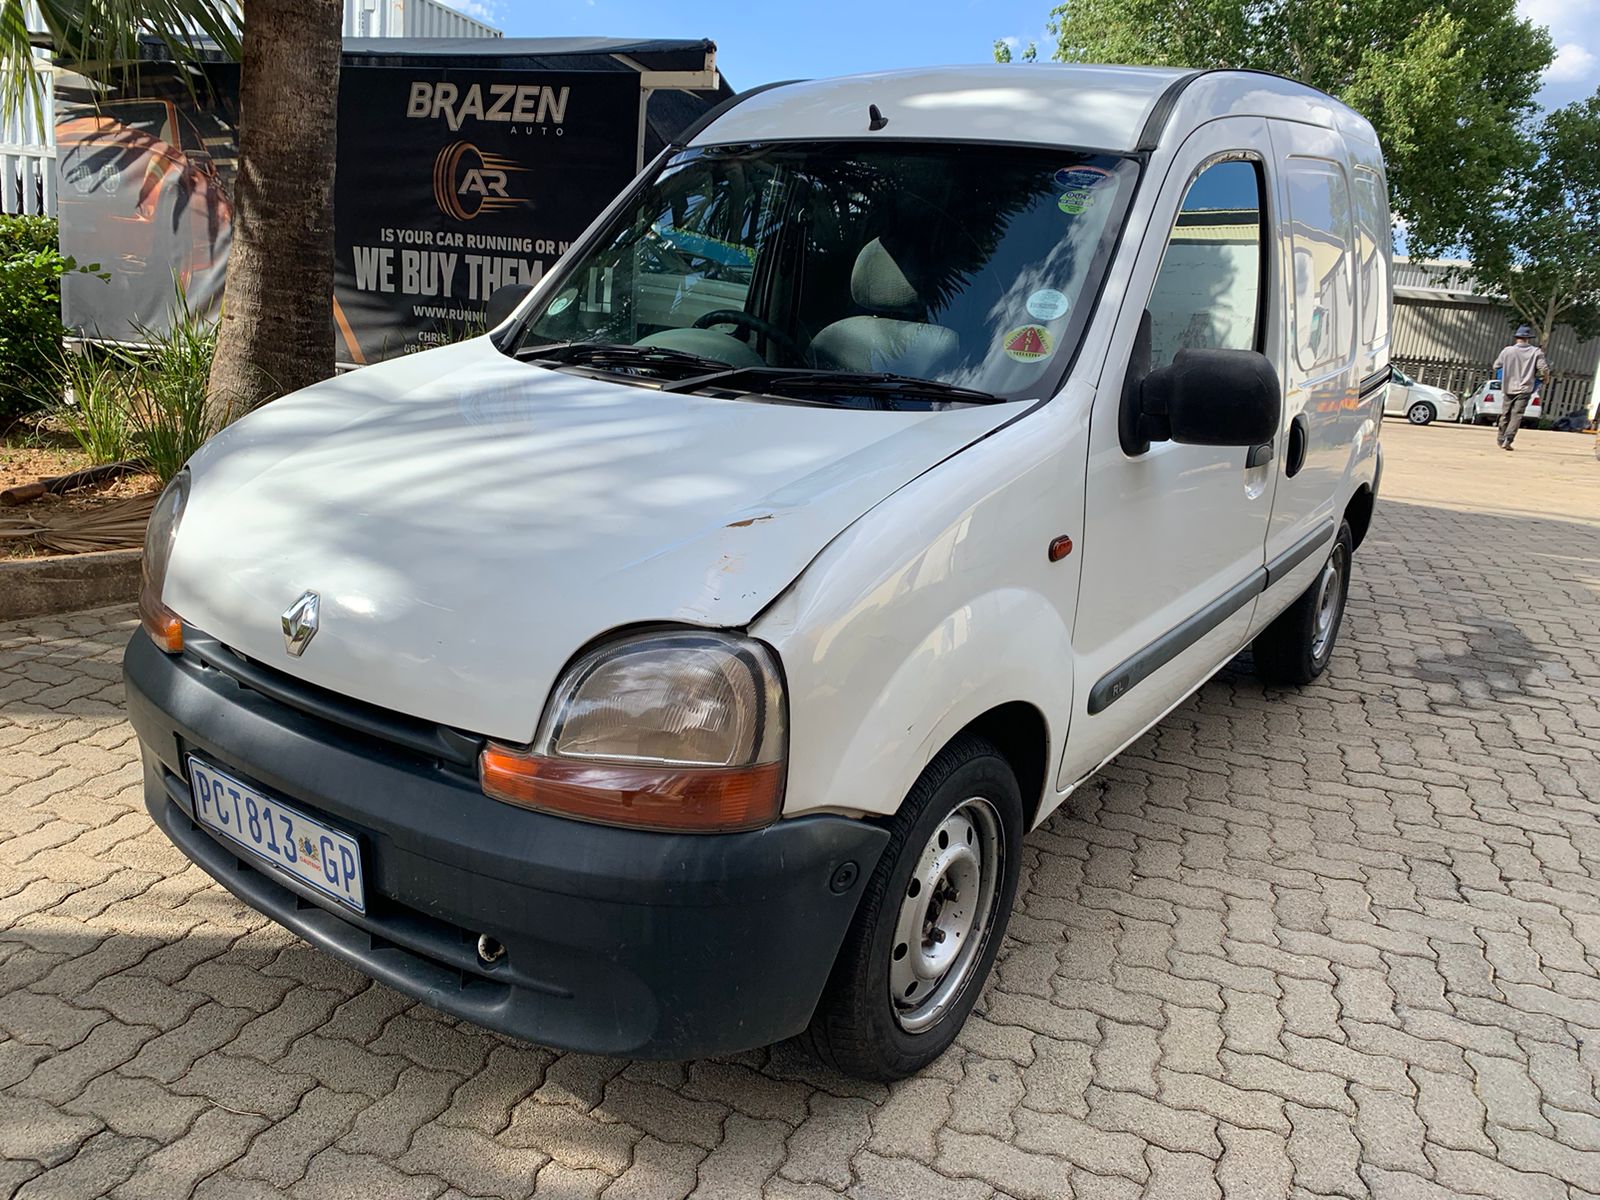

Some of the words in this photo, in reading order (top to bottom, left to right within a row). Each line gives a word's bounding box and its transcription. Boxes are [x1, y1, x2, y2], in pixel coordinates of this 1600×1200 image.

[407, 82, 570, 131] BRAZEN
[510, 126, 564, 136] AUTO
[457, 168, 510, 197] AR
[381, 228, 395, 242] IS
[396, 229, 433, 245] YOUR
[436, 232, 464, 247] CAR
[467, 234, 532, 252] RUNNING
[535, 240, 556, 255] OR
[559, 241, 576, 255] N
[352, 246, 395, 293] WE
[402, 249, 458, 298] BUY
[465, 254, 543, 302] THEM
[1112, 681, 1124, 697] RL
[195, 770, 298, 864] PCT813
[319, 835, 356, 893] GP
